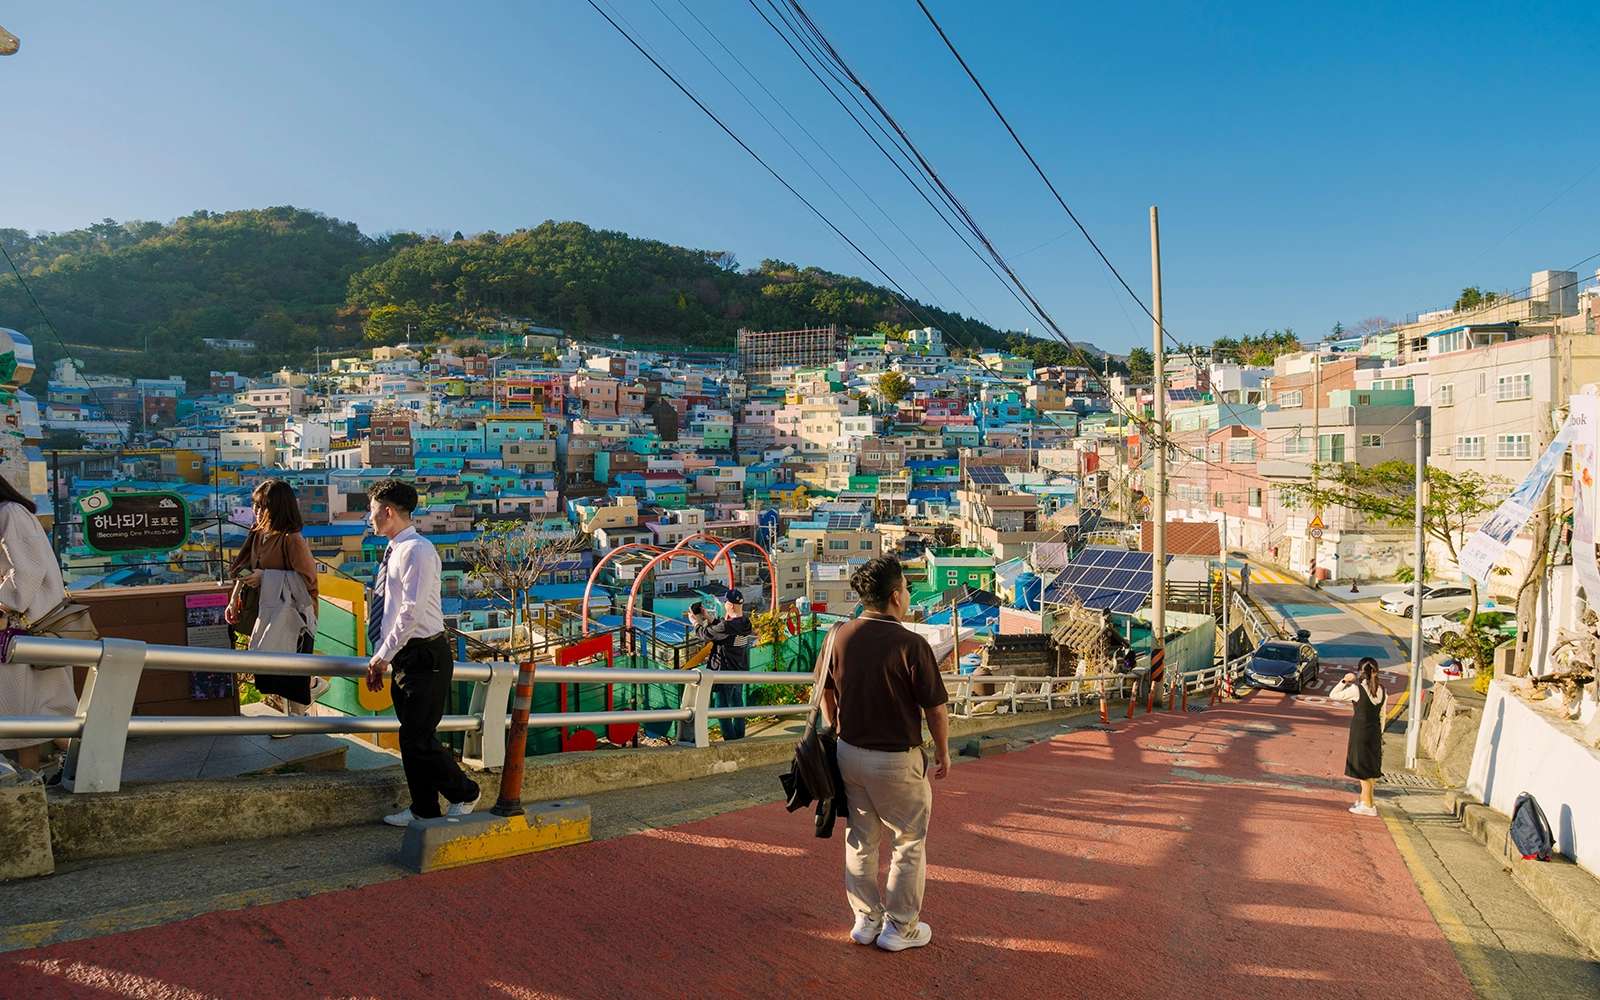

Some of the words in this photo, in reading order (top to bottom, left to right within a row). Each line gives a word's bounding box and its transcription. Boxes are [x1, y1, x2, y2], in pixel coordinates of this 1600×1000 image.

[1569, 413, 1588, 427] bok
[93, 513, 149, 529] 하나되기
[151, 516, 179, 526] 포토존
